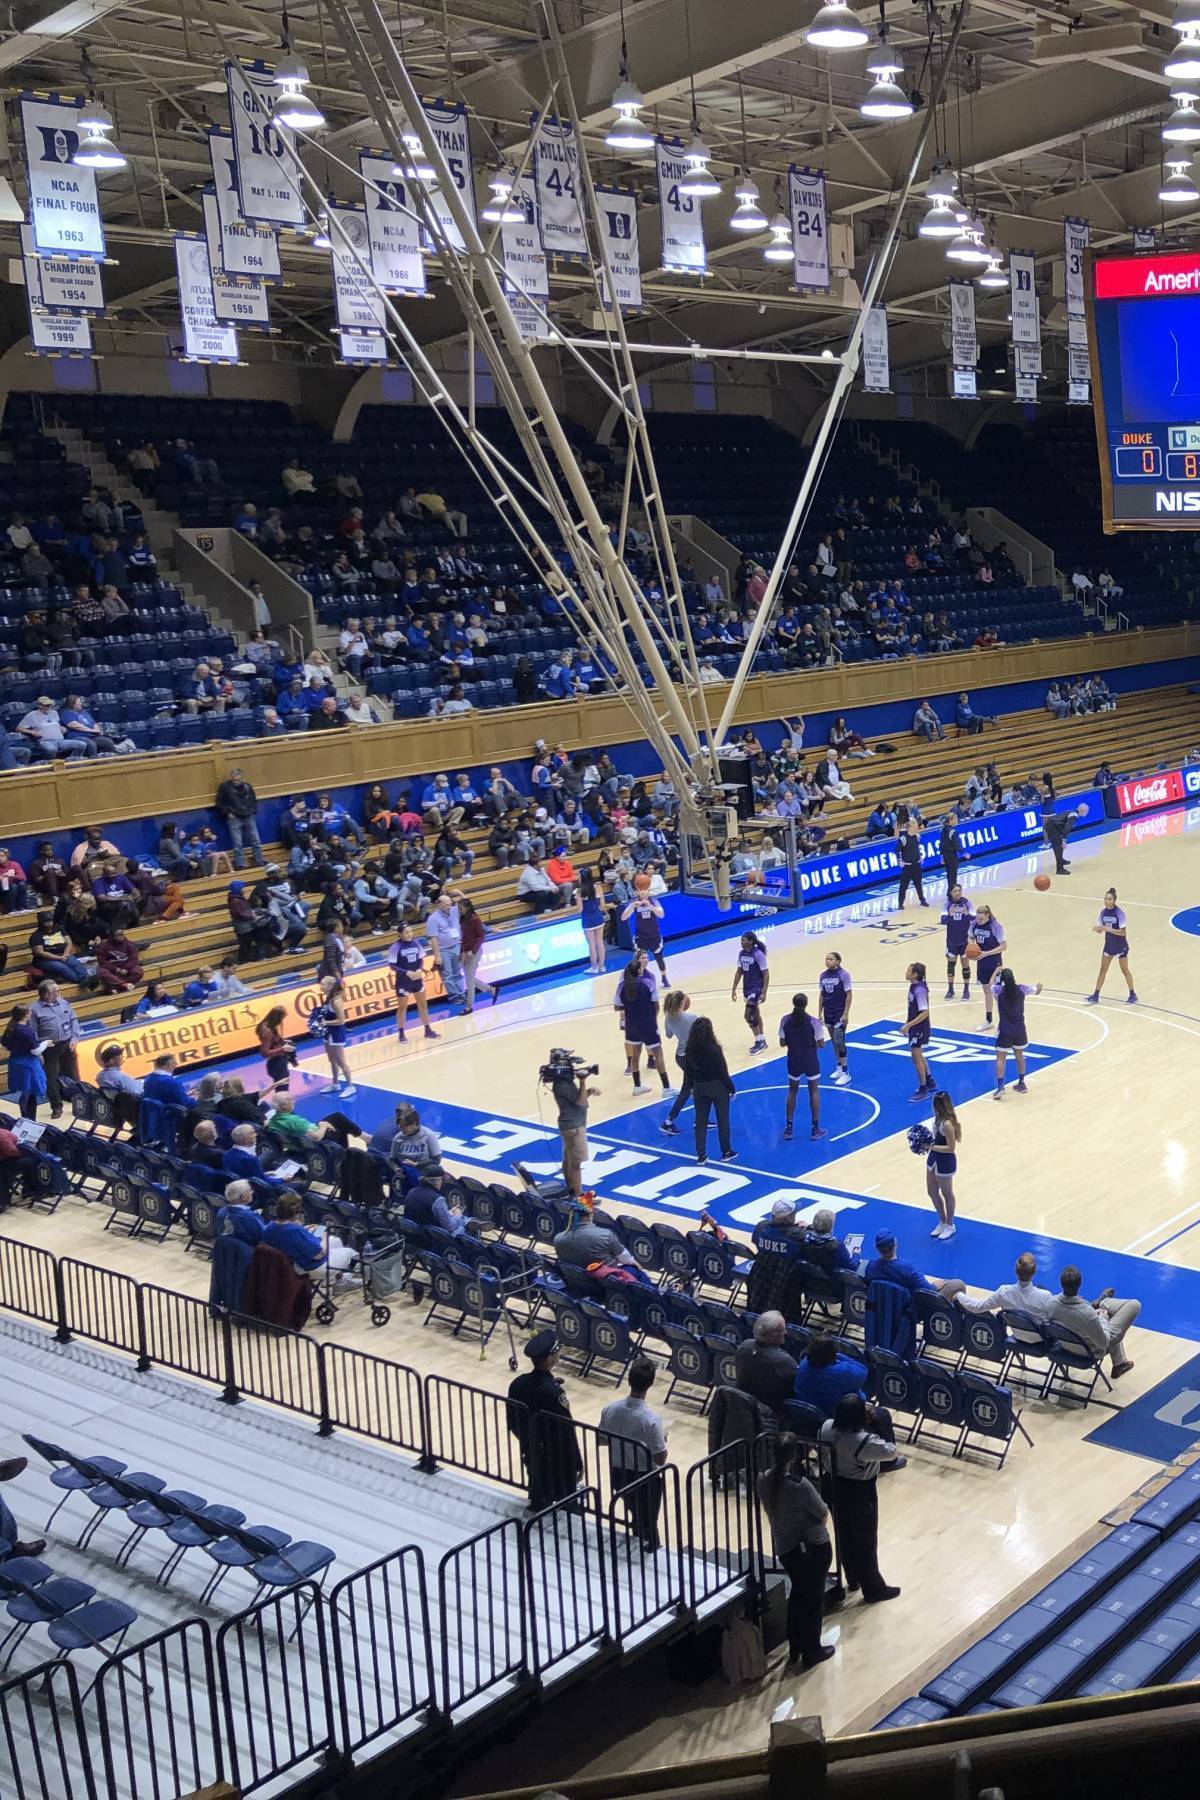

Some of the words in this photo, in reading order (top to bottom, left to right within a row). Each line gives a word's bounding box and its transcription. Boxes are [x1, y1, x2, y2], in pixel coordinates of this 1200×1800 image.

[248, 122, 285, 157] 10
[432, 129, 466, 153] YMAN
[661, 161, 692, 181] GMINS
[51, 179, 79, 193] NCAA
[546, 168, 577, 199] 44
[36, 198, 67, 210] FINAL
[70, 201, 97, 213] FOUR
[794, 189, 823, 209] DAWKINS
[798, 210, 823, 238] 24
[57, 230, 84, 242] 1963
[224, 225, 250, 238] FINAL
[254, 228, 274, 239] FOUR
[383, 226, 406, 238] NCAA
[243, 255, 263, 266] 1964
[44, 262, 97, 275] CHAMPIONS
[61, 290, 86, 301] 1954
[232, 304, 254, 314] 1958
[52, 332, 74, 343] 1999
[1122, 433, 1153, 445] DUKE
[1142, 450, 1155, 474] 0
[801, 866, 842, 891] DUKE
[846, 855, 899, 879] WOMEN
[919, 826, 999, 859] BASTBALL
[879, 926, 938, 944] COU
[758, 1238, 788, 1255] DUKE
